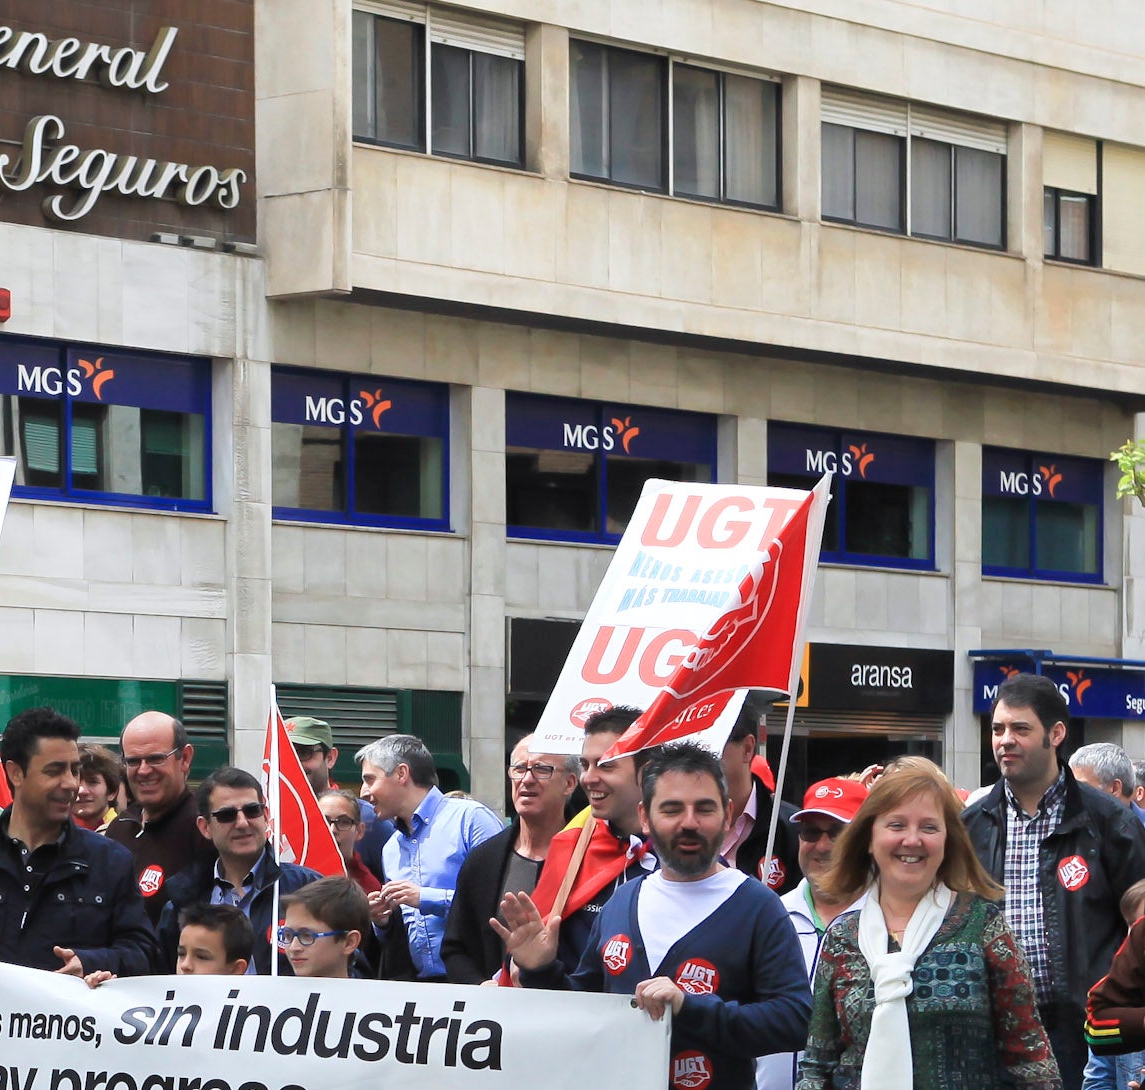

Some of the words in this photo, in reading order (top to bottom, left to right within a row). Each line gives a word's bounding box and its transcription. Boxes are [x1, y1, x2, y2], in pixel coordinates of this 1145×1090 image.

[17, 364, 83, 396] MGS
[305, 396, 363, 425] MGS
[563, 423, 615, 450] MGS
[806, 448, 853, 475] MGS
[1000, 471, 1042, 495] MGS
[641, 494, 807, 551] UGT
[581, 626, 698, 687] UG
[851, 663, 913, 689] aransa
[605, 940, 629, 958] UGT
[682, 962, 716, 985] UGT
[9, 1012, 102, 1048] manos,
[114, 991, 203, 1048] sin
[213, 989, 502, 1071] industria
[674, 1056, 705, 1074] UGT
